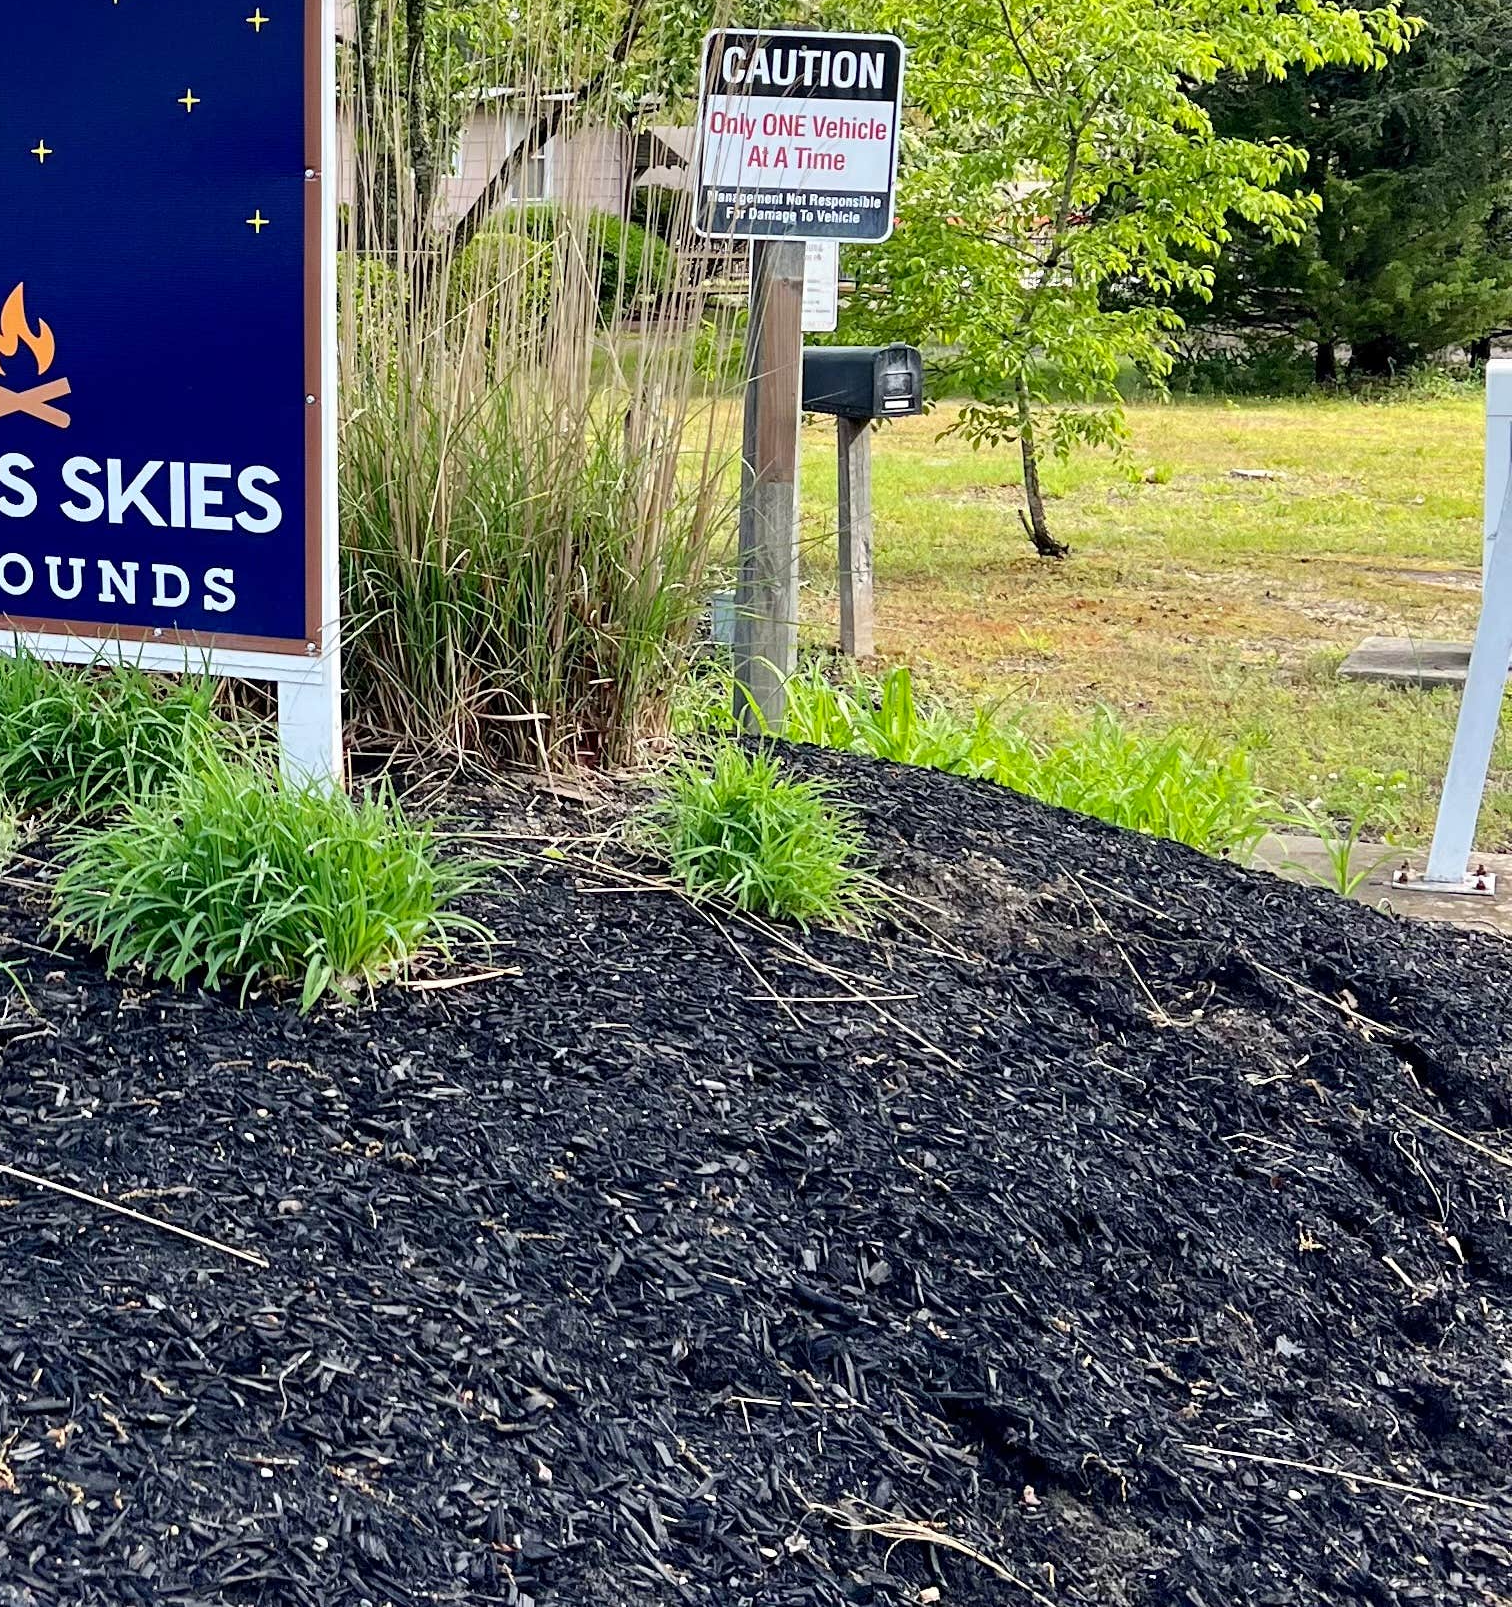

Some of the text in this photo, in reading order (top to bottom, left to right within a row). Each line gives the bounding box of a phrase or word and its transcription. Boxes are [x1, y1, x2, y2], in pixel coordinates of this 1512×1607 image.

[722, 46, 885, 89] CAUTION
[710, 111, 887, 141] Only ONE Vehicle
[747, 145, 846, 171] At A Time
[787, 193, 806, 206] Not
[810, 194, 882, 209] Responsible
[749, 208, 797, 224] Damage
[800, 209, 814, 222] To
[817, 210, 861, 224] Vehicle
[60, 456, 282, 534] SKIES
